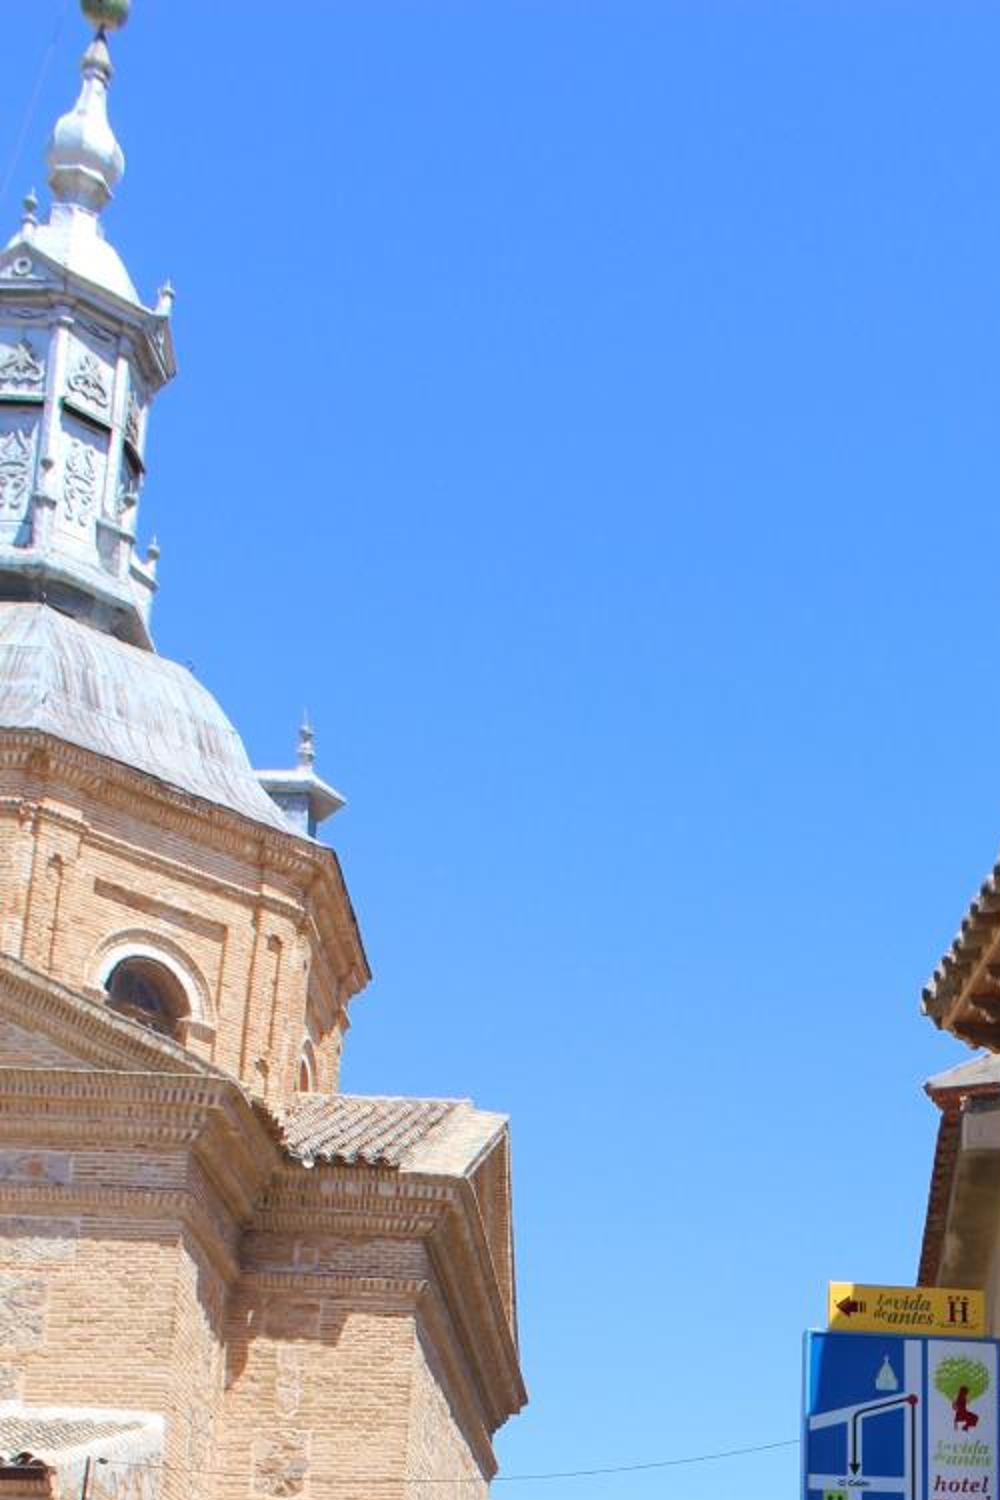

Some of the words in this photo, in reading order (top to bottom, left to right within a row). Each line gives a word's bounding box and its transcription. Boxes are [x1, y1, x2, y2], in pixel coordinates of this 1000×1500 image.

[893, 1294, 931, 1311] vida
[887, 1311, 935, 1326] antes
[948, 1301, 969, 1323] H
[953, 1439, 989, 1455] vida
[934, 1475, 988, 1493] hotel
